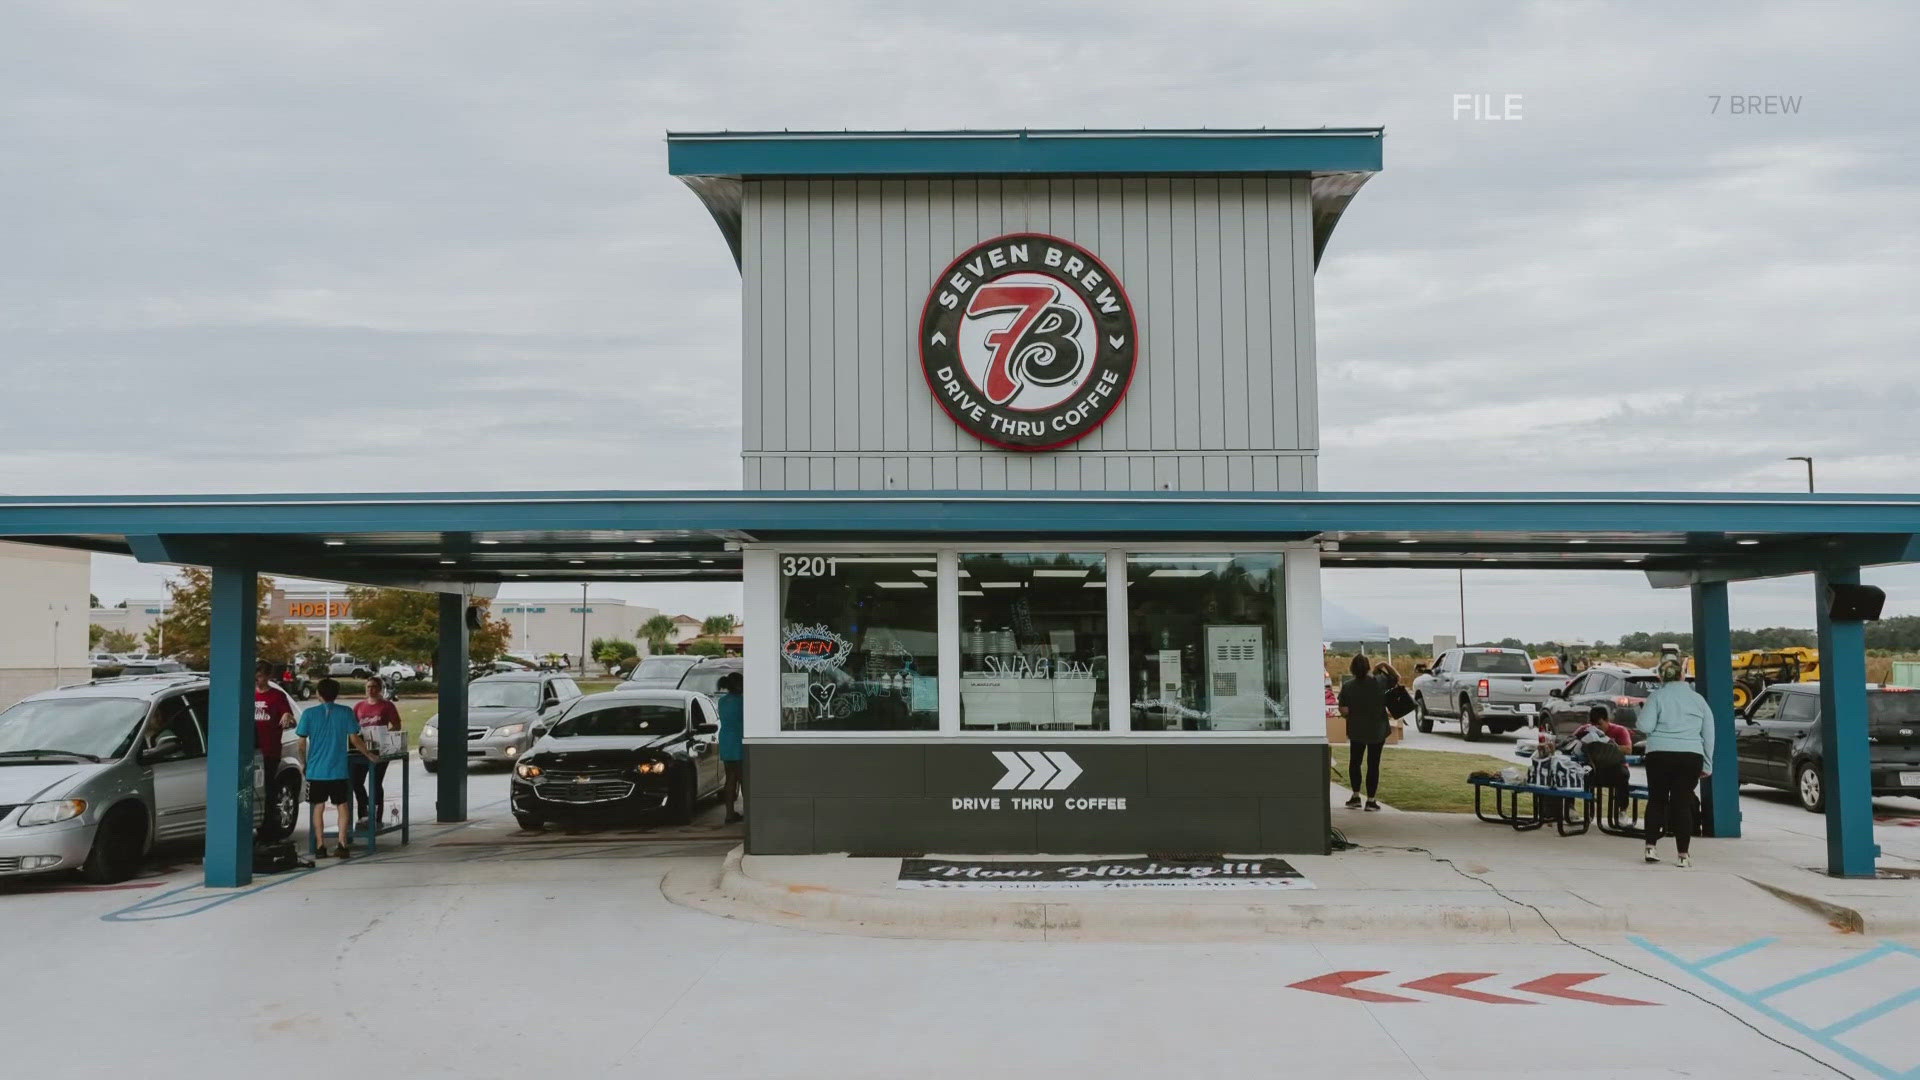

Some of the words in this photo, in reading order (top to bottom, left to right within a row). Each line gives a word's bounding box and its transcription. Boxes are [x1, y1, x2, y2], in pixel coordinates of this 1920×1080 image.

[939, 244, 1030, 311] SEVEN
[1044, 247, 1121, 315] BREW
[936, 366, 987, 423] DRIVE
[989, 414, 1046, 437] THRU
[1051, 369, 1120, 432] COFFEE
[782, 556, 838, 577] 3201
[289, 602, 351, 618] HOBBY
[784, 639, 835, 655] OPEN
[982, 655, 1050, 680] SWAG
[1057, 660, 1095, 680] DAY
[951, 797, 1001, 811] DRIVE
[1011, 797, 1054, 811] THRU
[1065, 797, 1127, 811] COFFEE
[929, 865, 1044, 878] Now
